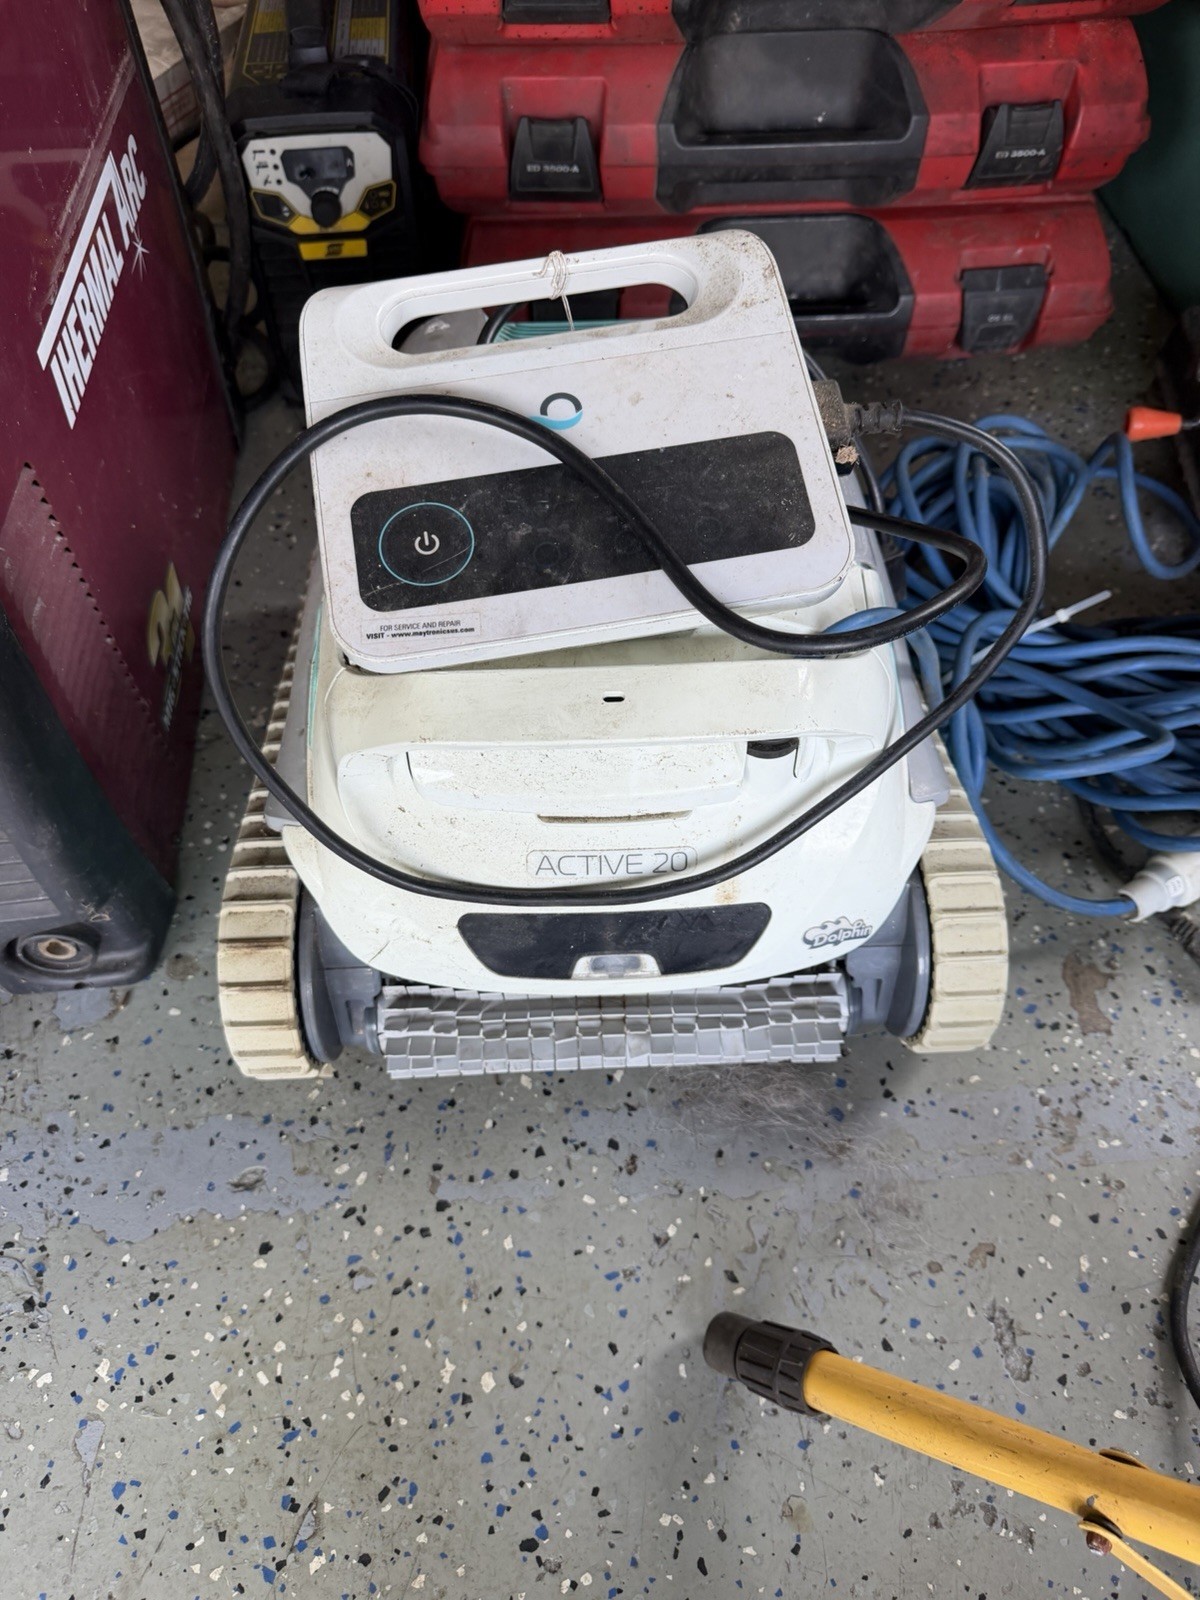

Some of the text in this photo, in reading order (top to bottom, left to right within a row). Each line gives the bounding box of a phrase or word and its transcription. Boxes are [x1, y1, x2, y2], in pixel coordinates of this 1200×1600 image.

[37, 133, 146, 430] THERMAL ARC
[366, 632, 385, 640] VISIT
[391, 627, 475, 639] www.maytronicsus.com
[380, 620, 461, 632] FOR SERVICE AND REPAIR
[535, 853, 644, 876] ACTIVE
[652, 851, 689, 874] 20
[810, 921, 874, 948] Dolphin
